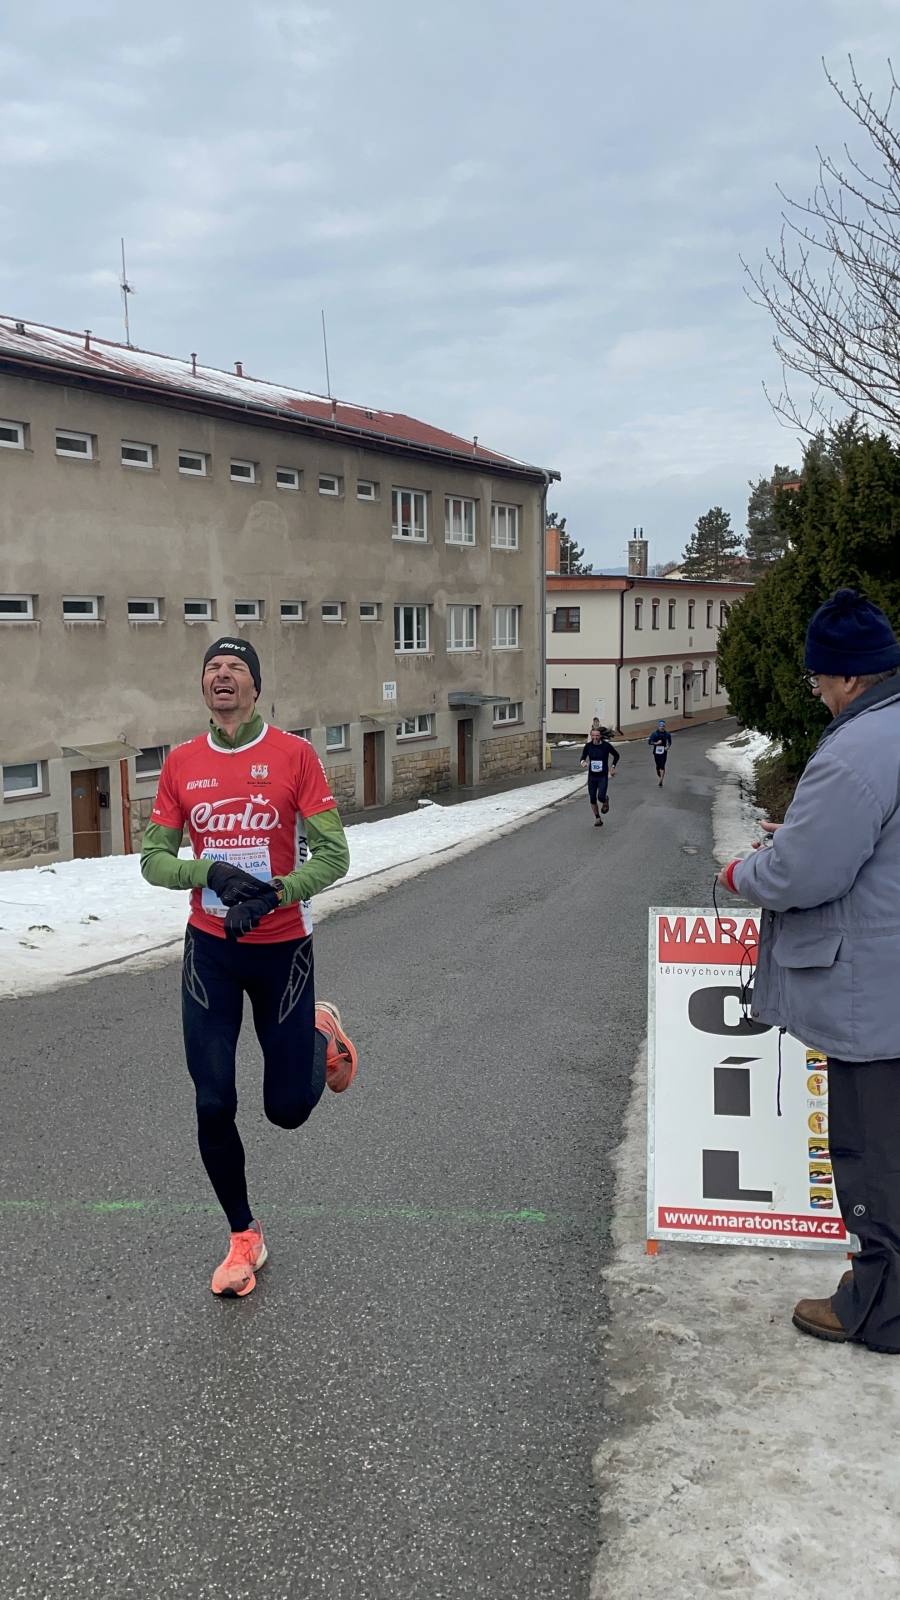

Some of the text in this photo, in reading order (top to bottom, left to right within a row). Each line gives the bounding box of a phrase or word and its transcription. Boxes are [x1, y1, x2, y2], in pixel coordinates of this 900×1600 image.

[190, 802, 278, 833] Carla
[203, 835, 270, 848] Chocolates
[245, 861, 268, 869] LIGA
[660, 966, 741, 977] tělovýchovná
[664, 1211, 840, 1234] www.maratonstav.cz
